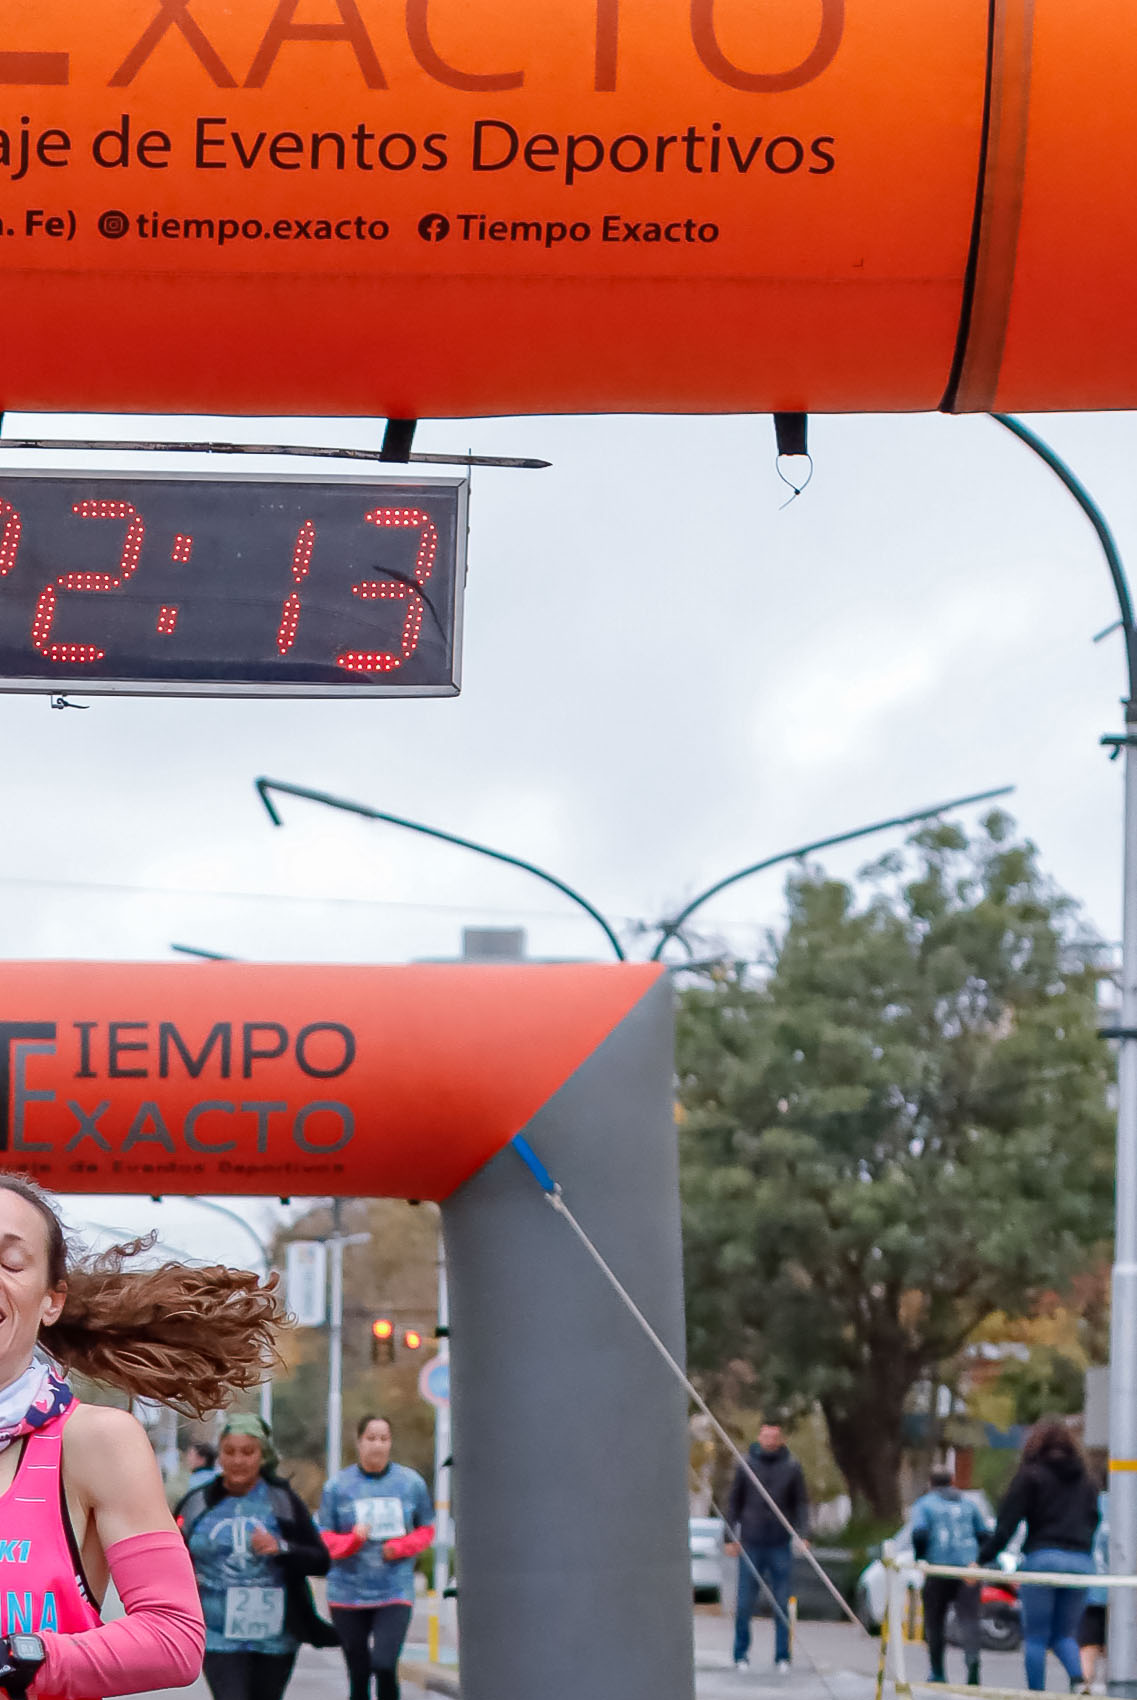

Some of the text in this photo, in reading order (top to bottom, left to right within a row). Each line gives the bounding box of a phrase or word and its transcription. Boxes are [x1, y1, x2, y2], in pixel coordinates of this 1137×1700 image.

[92, 114, 171, 168] de
[195, 117, 449, 171] Eventos
[471, 119, 836, 186] Deportivos
[25, 209, 77, 241] Fe)
[137, 212, 390, 246] tiempo.exacto
[457, 213, 591, 248] Tiempo
[602, 215, 720, 245] Exacto
[13, 1044, 356, 1155] EXACTO
